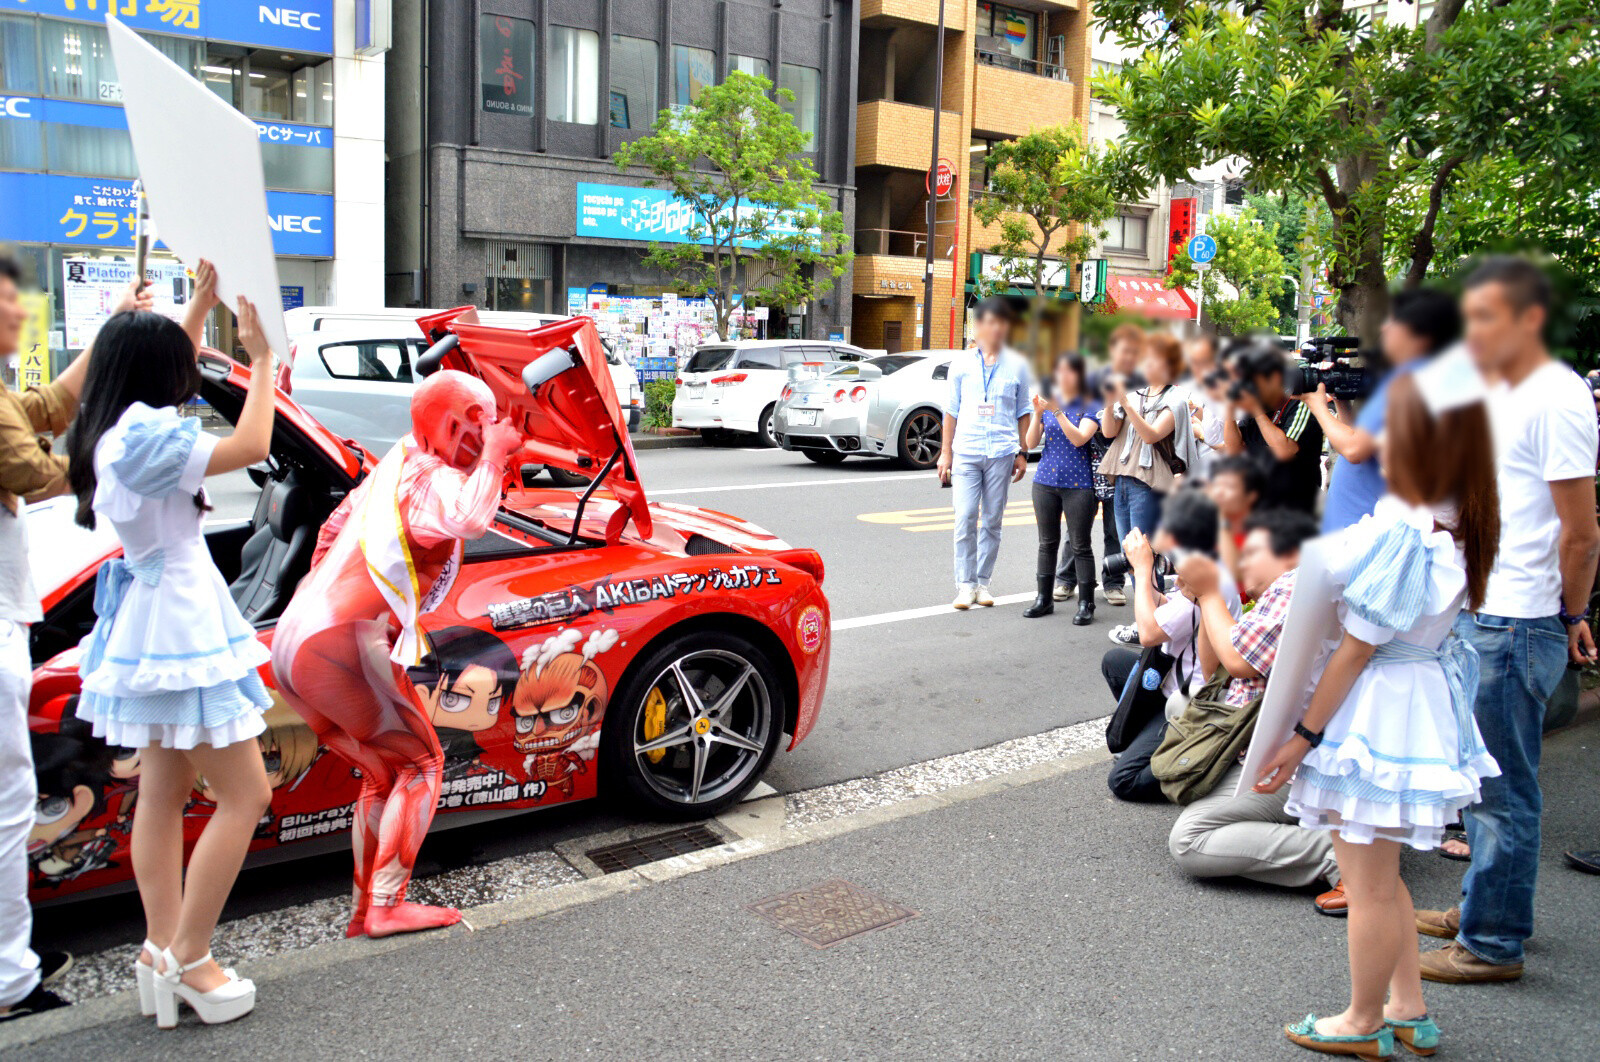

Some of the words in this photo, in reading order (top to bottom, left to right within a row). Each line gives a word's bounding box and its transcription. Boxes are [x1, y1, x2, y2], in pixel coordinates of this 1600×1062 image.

[259, 6, 321, 31] NEC
[257, 125, 321, 144] PCサーバ
[268, 215, 322, 234] NEC
[1194, 241, 1206, 259] P
[1201, 251, 1210, 259] 60
